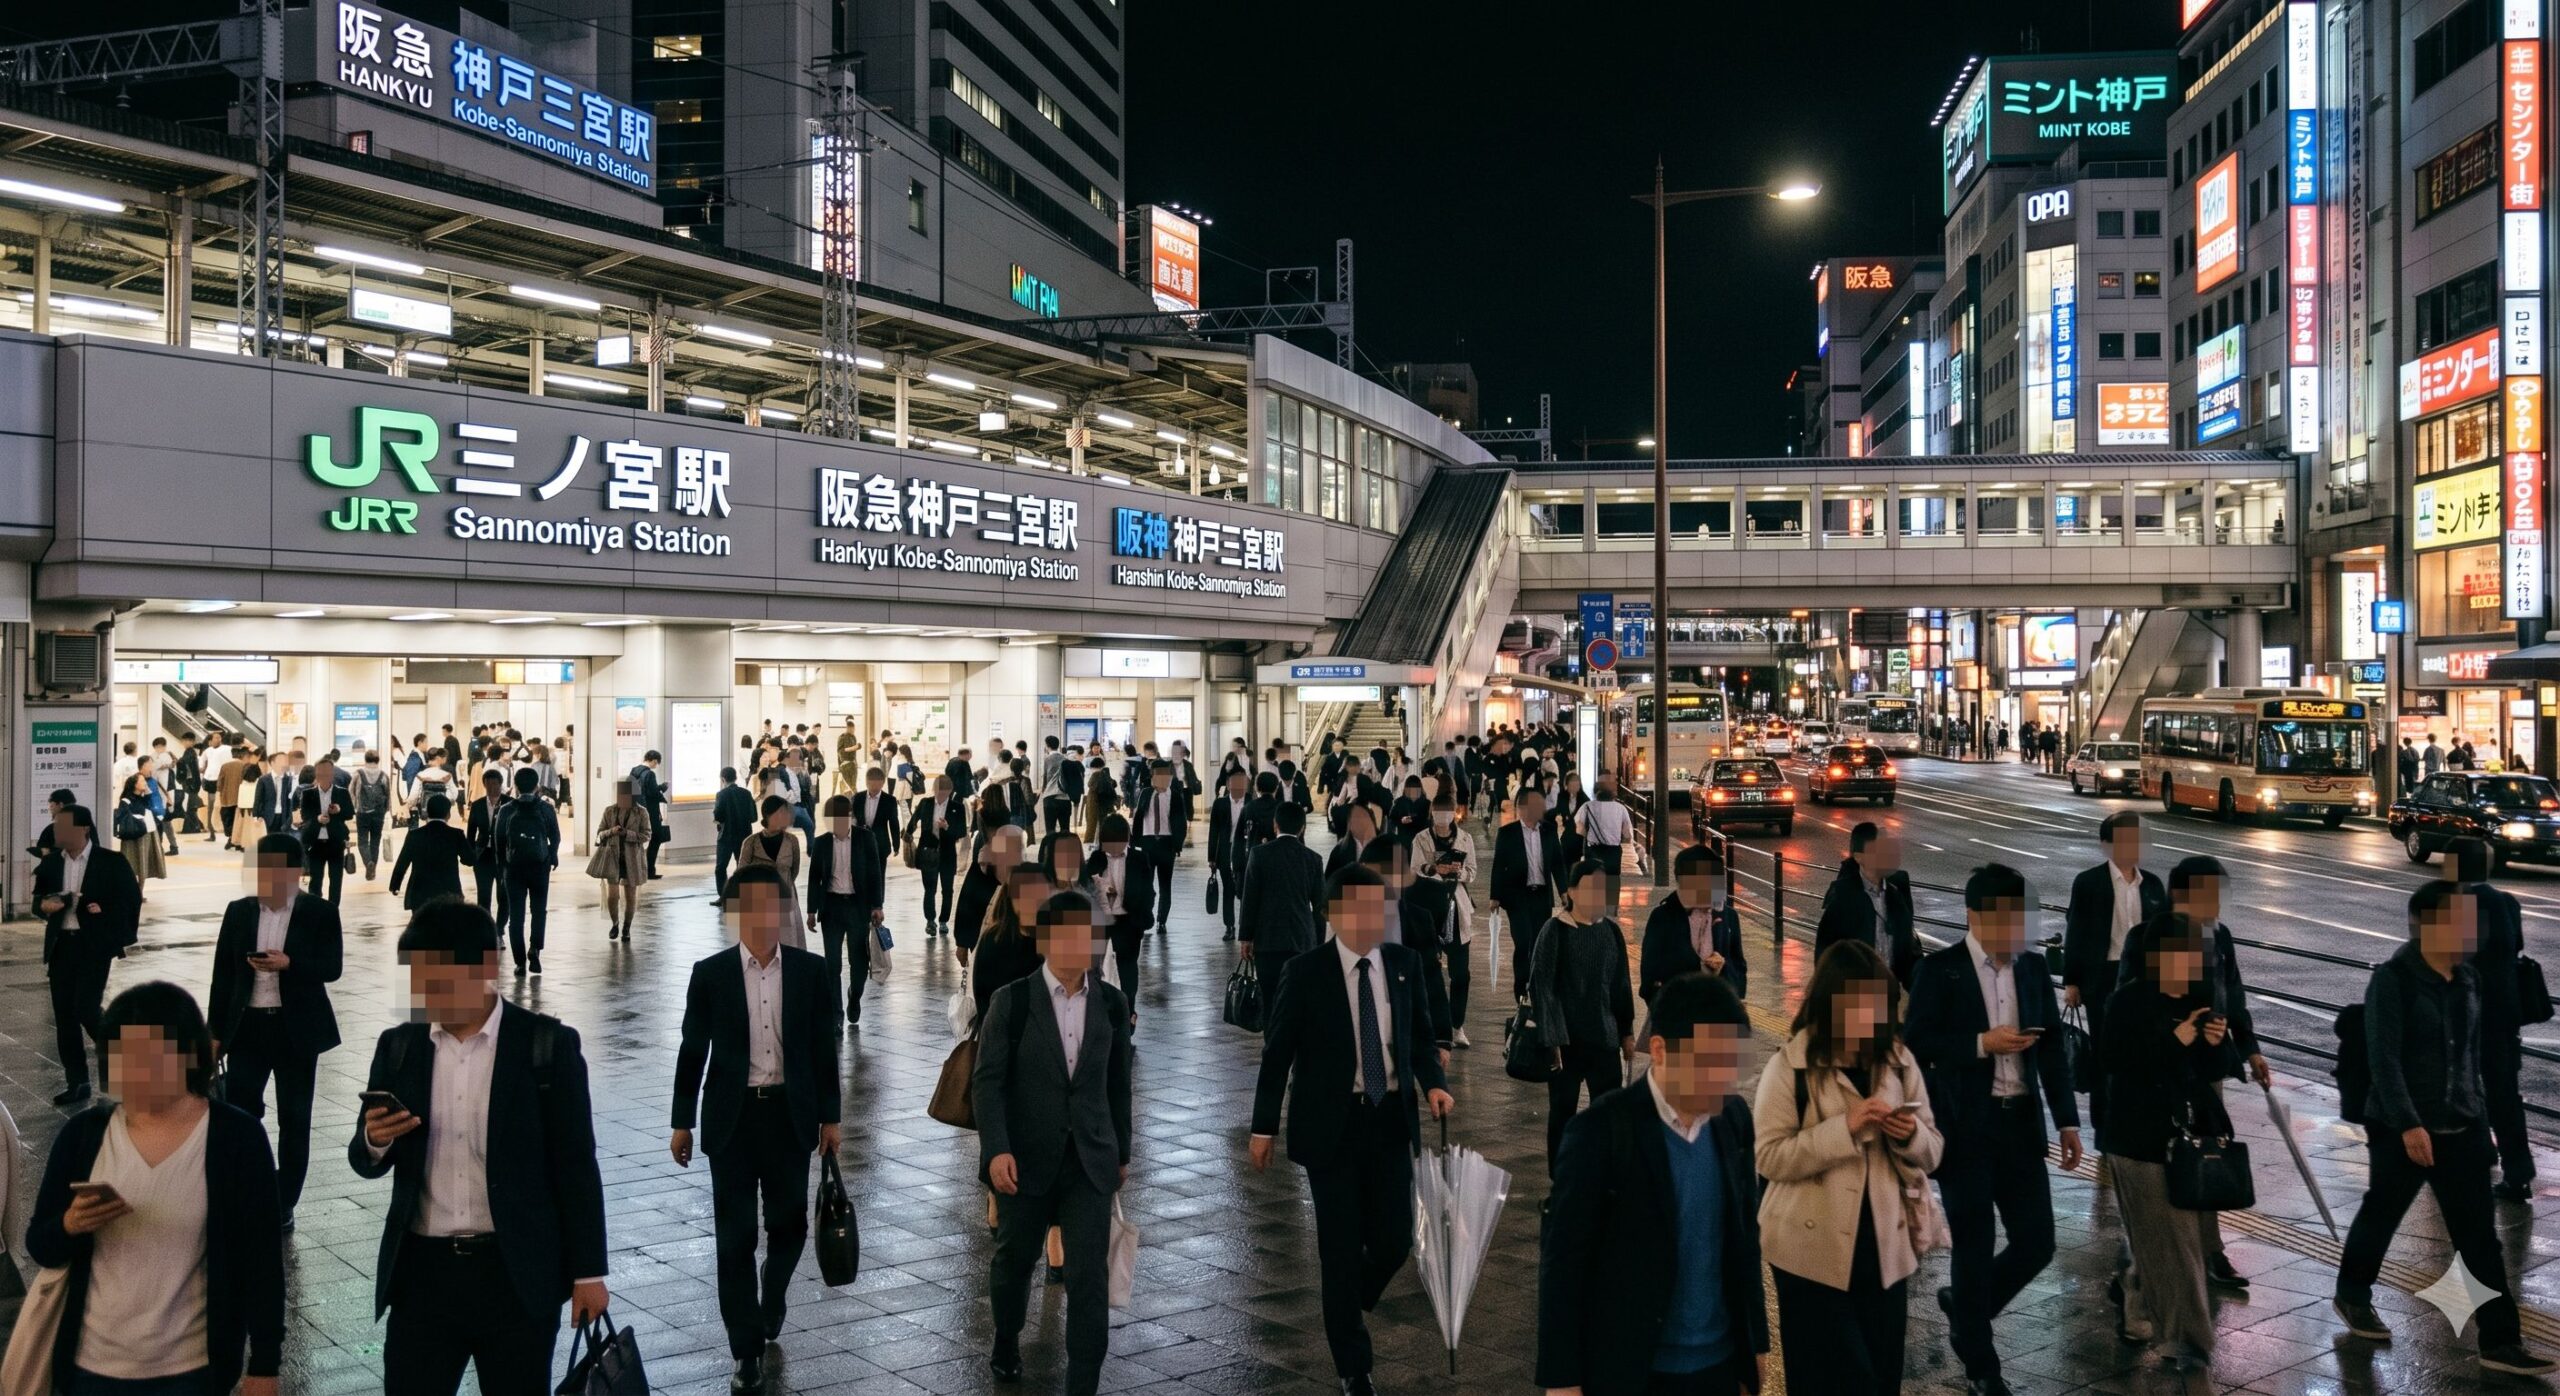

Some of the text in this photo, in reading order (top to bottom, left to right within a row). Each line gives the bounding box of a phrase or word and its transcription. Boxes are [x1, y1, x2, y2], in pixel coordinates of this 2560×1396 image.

[339, 2, 434, 79] 阪急
[340, 60, 433, 109] HANKYU
[453, 40, 650, 161] 神戸三宮駅
[2004, 76, 2168, 115] ミント神戸
[454, 98, 649, 188] Kobe-Sannomiya Station
[2039, 121, 2131, 138] MINT KOBE
[2295, 116, 2313, 198] ミント神戸
[2027, 189, 2070, 223] OPA
[1845, 265, 1894, 290] 阪急
[305, 405, 441, 494] JR
[451, 422, 732, 518] 三ノ宮駅
[452, 506, 731, 556] Sannomiya Station
[817, 467, 1079, 552] 阪急神戸三宮駅
[818, 537, 1079, 582] Hankyu Kobe-Sannomiya Station
[1115, 506, 1285, 574] 阪神 神戸三宮駅
[1115, 564, 1287, 599] Hanshin Kobe-Sannomiya Station
